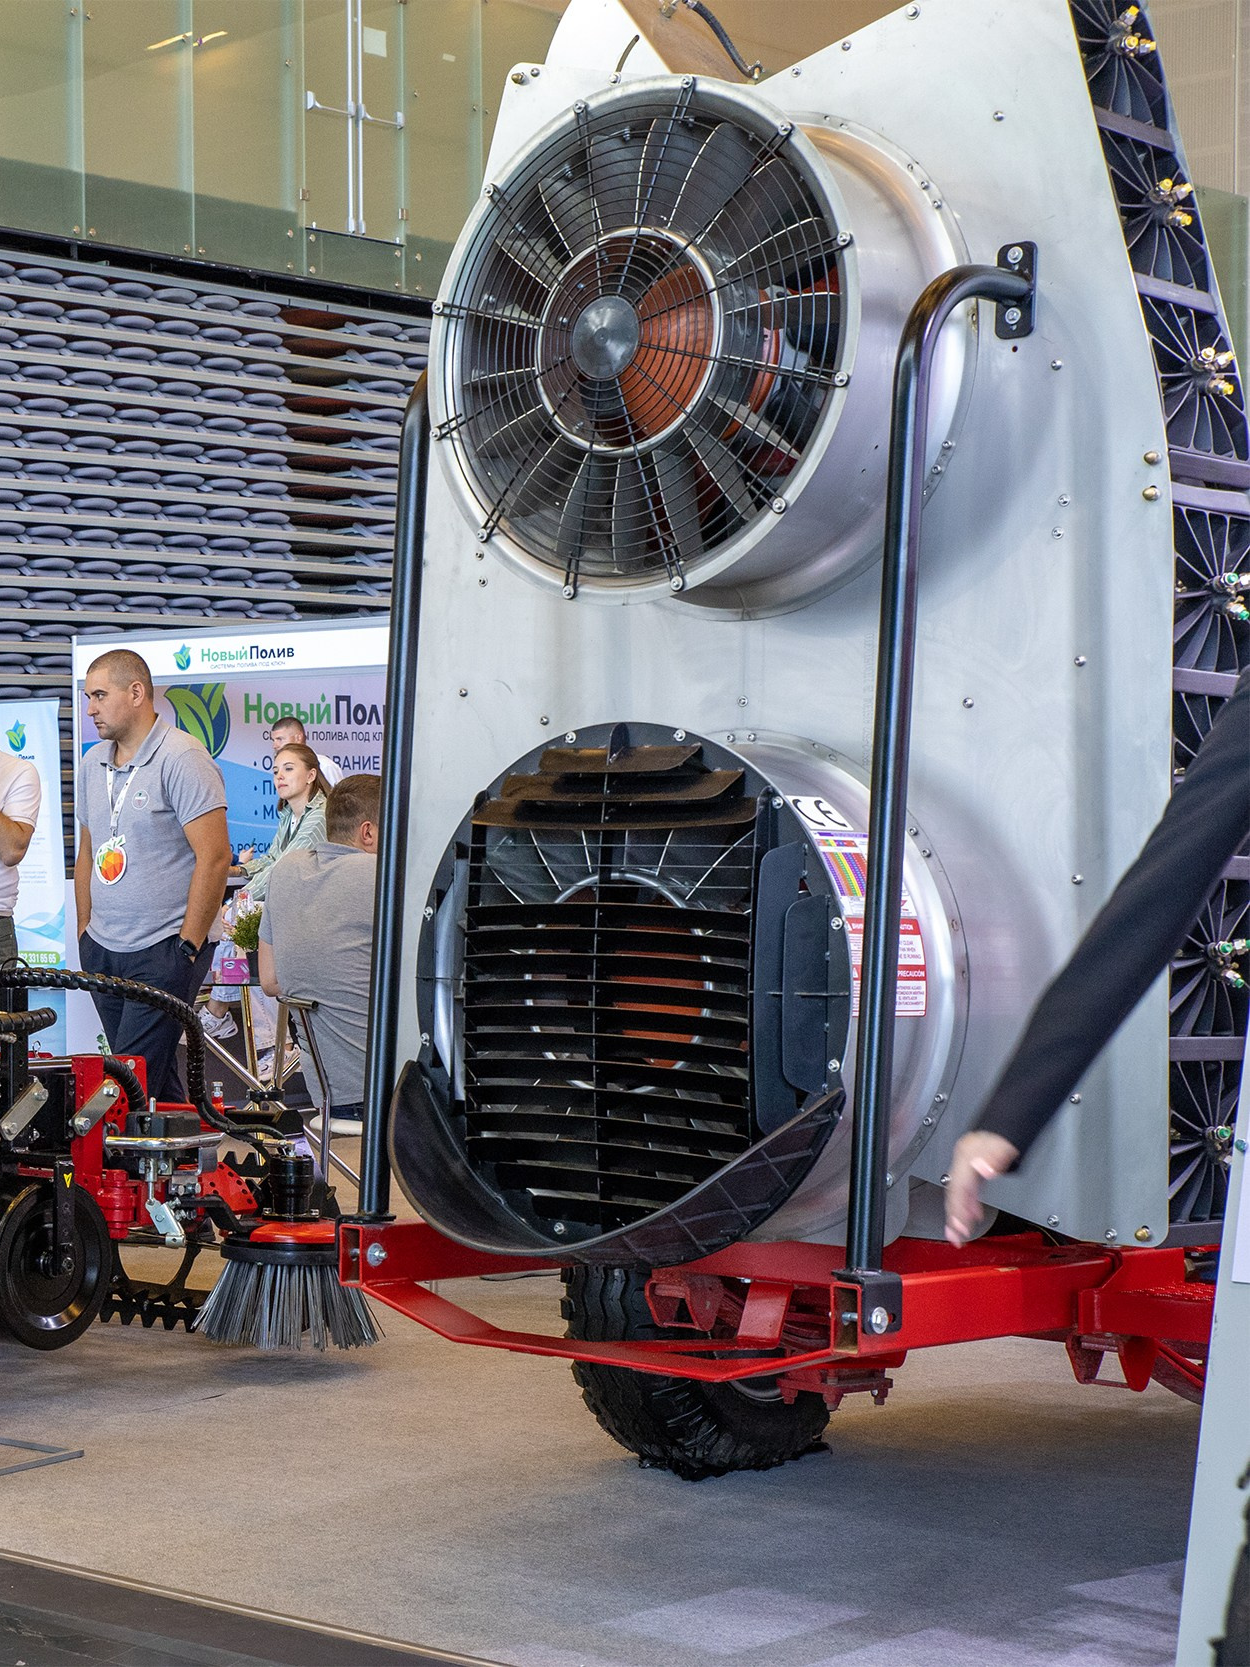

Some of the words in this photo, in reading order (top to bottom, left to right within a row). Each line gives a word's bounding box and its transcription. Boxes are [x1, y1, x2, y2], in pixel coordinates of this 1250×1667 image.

[244, 692, 385, 725] НовыйПол
[312, 732, 348, 740] ПОЛИВА
[352, 732, 370, 742] ПОД
[238, 843, 272, 854] РОССИ
